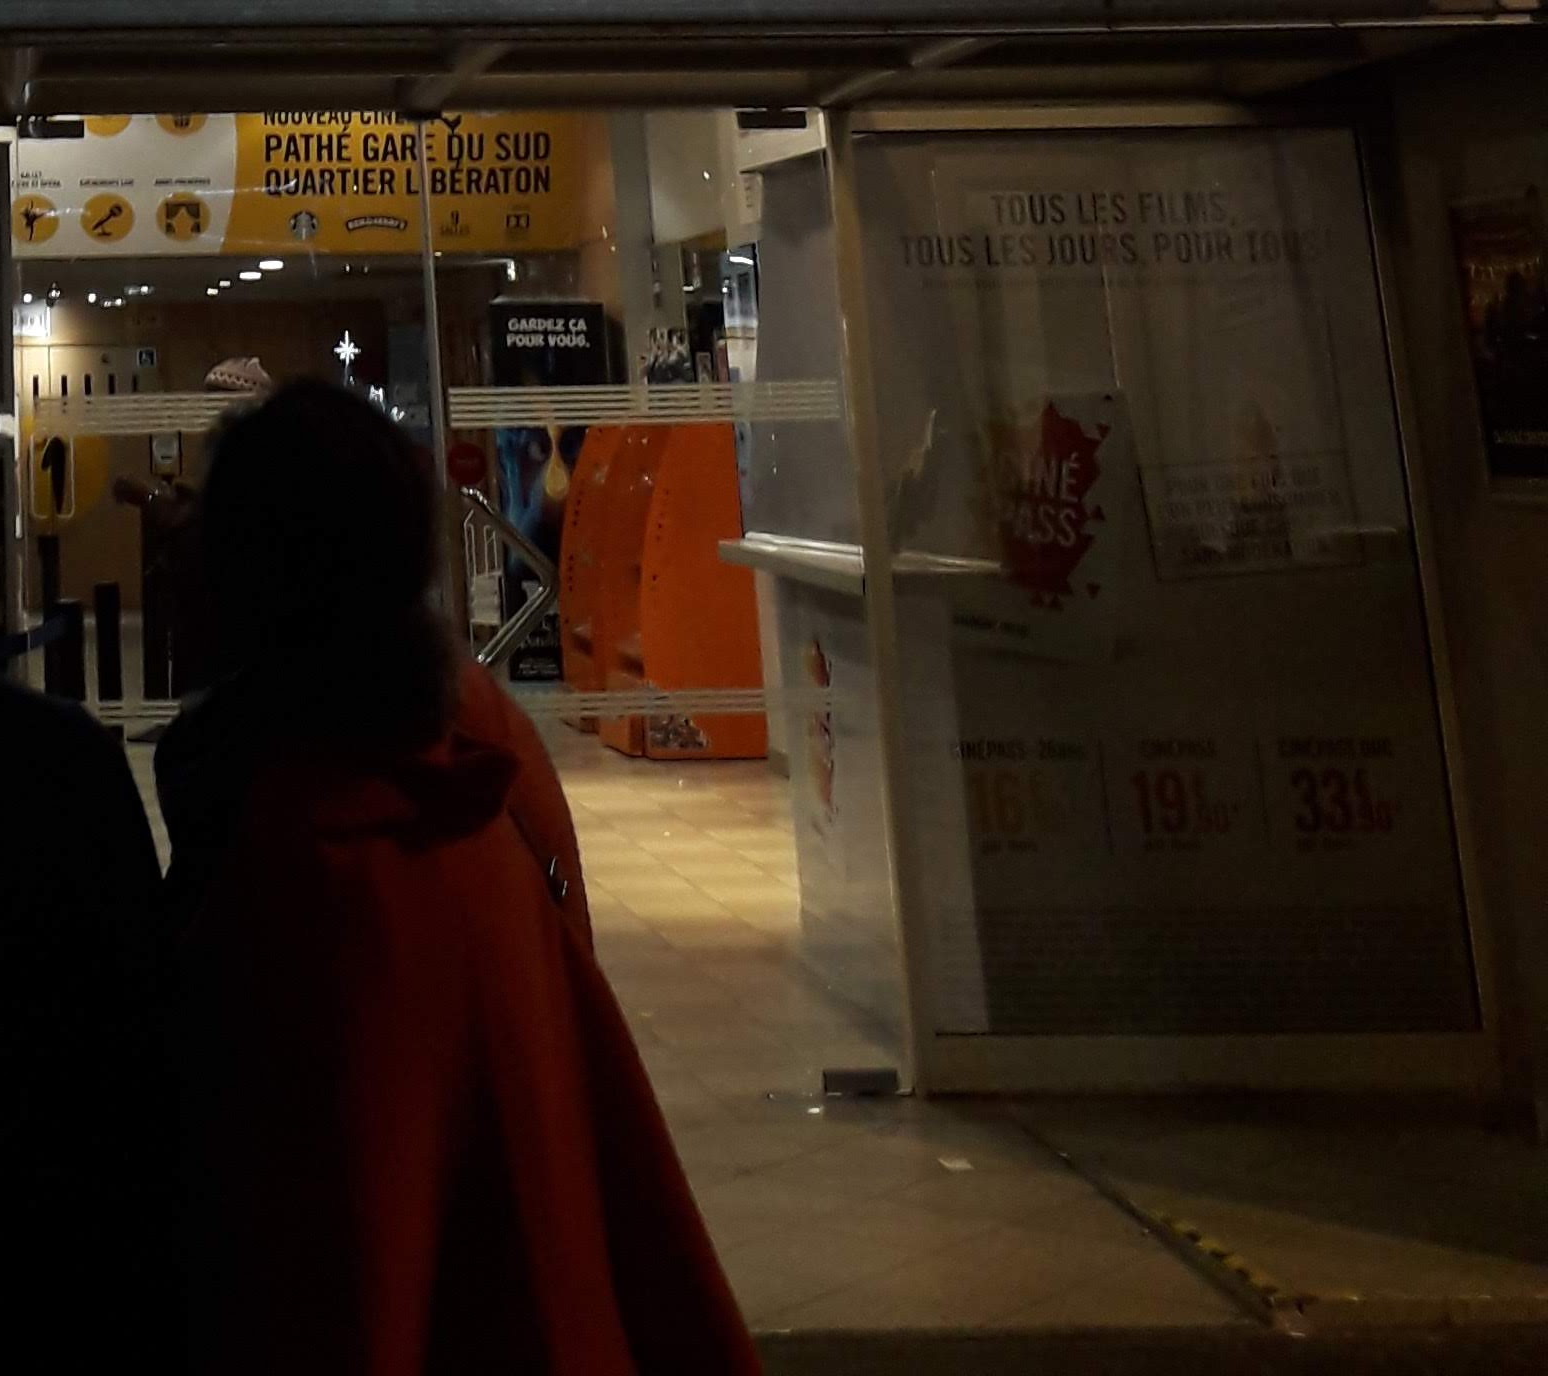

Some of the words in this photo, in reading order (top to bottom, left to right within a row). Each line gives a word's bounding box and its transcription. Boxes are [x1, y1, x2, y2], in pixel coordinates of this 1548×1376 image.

[265, 126, 352, 162] PATHÉ
[447, 133, 483, 161] DU
[495, 132, 550, 161] SUD
[265, 167, 394, 196] QUARTIER
[406, 159, 550, 195] LBÉRATON
[991, 191, 1065, 224] TOUS
[1078, 191, 1128, 224] LES
[900, 234, 974, 267] TOUS
[985, 234, 1036, 267] LES
[1154, 231, 1234, 264] POUR
[506, 333, 544, 347] POUR
[507, 317, 566, 333] GARDEZ
[568, 317, 588, 335] ÇA
